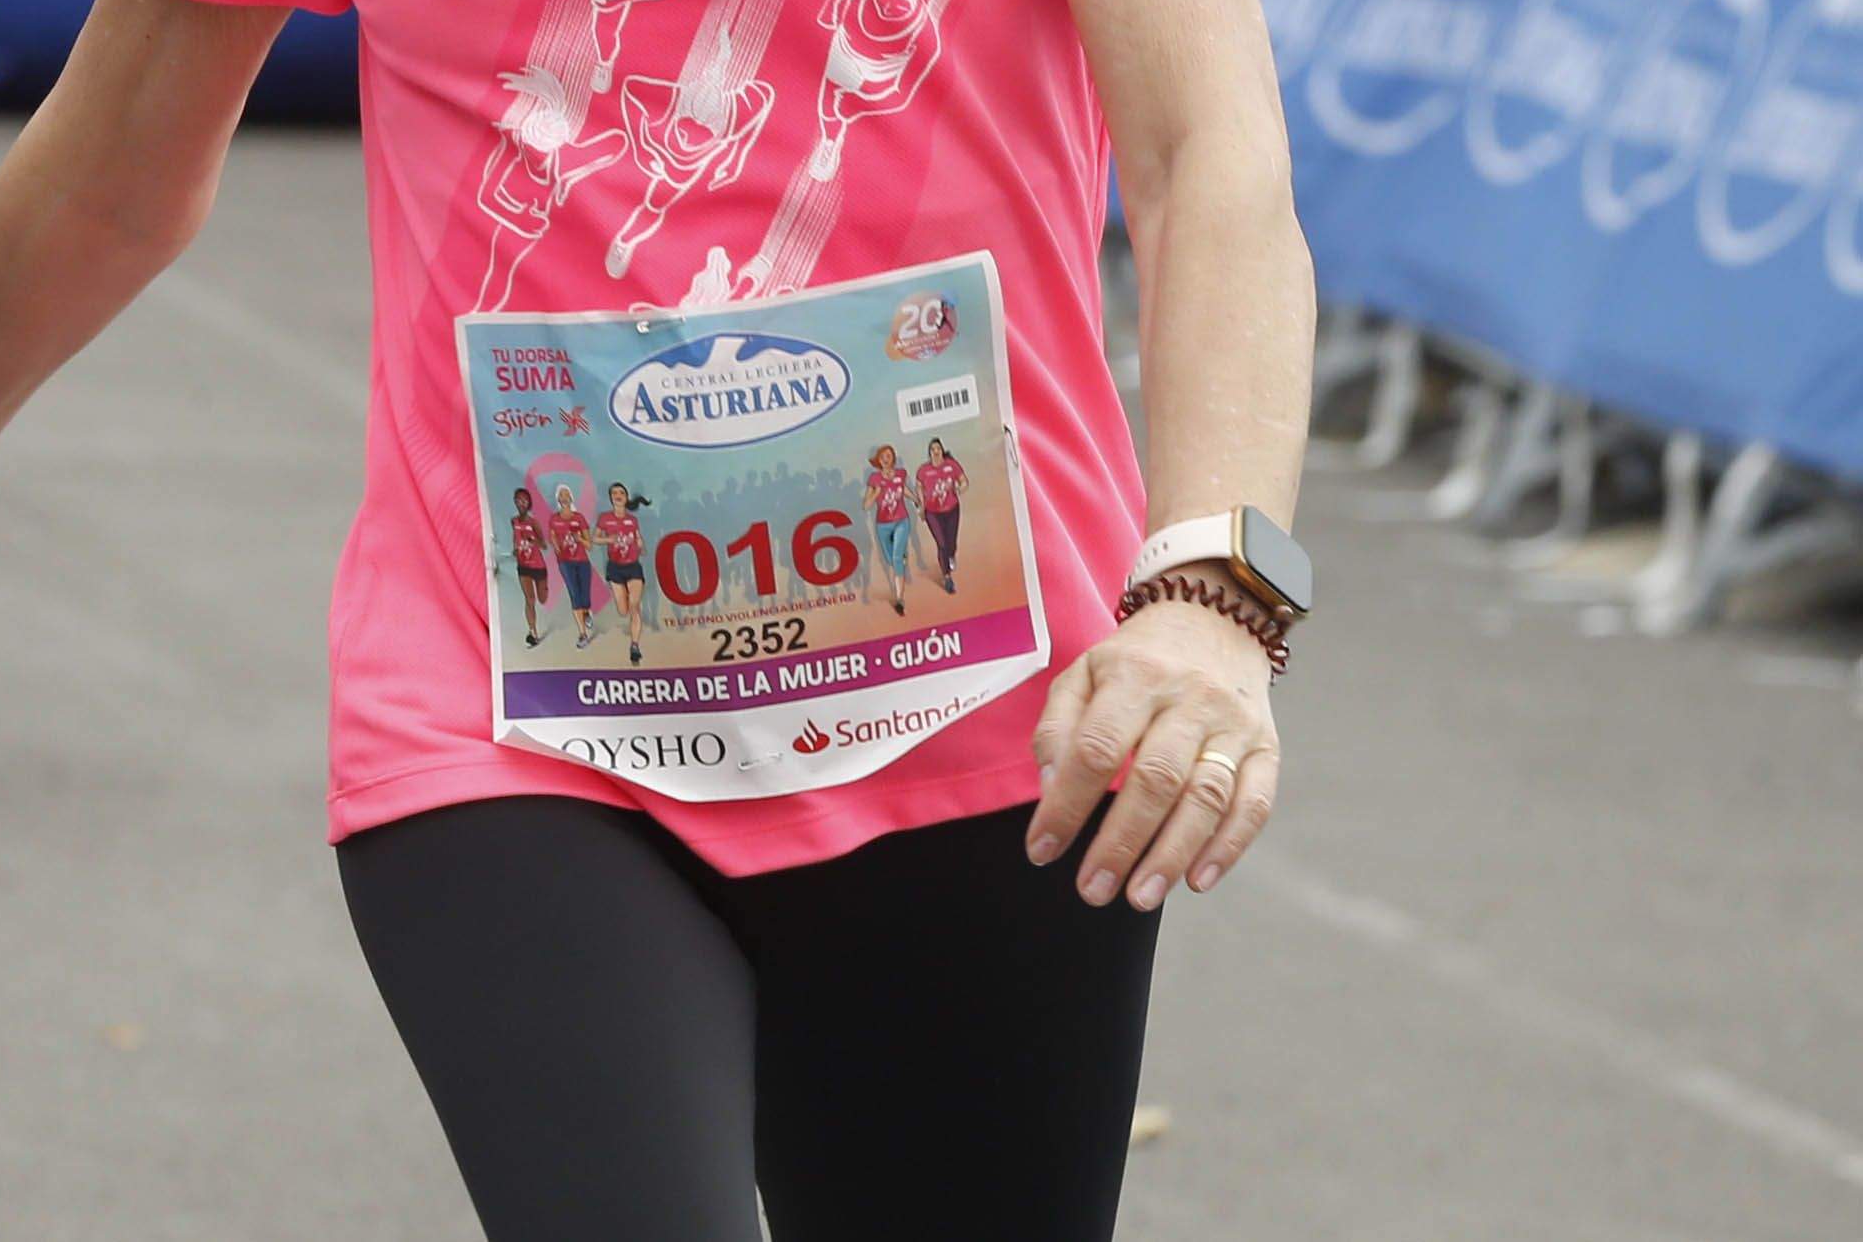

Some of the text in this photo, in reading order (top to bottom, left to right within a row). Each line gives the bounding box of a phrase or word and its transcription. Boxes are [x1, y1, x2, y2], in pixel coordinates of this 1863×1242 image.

[492, 349, 572, 364] TU DORSAL
[661, 358, 823, 389] CENTRAL LECHERA
[496, 366, 575, 392] SUMA
[629, 374, 835, 424] ASTURIANA
[655, 510, 860, 606] 016
[724, 604, 788, 623] VIOLENCIA
[710, 617, 808, 662] 2352
[577, 678, 690, 706] CARRERA
[697, 675, 730, 701] DE
[739, 670, 772, 698] LA
[780, 653, 868, 692] MUJER
[889, 630, 962, 670] GIJÓN
